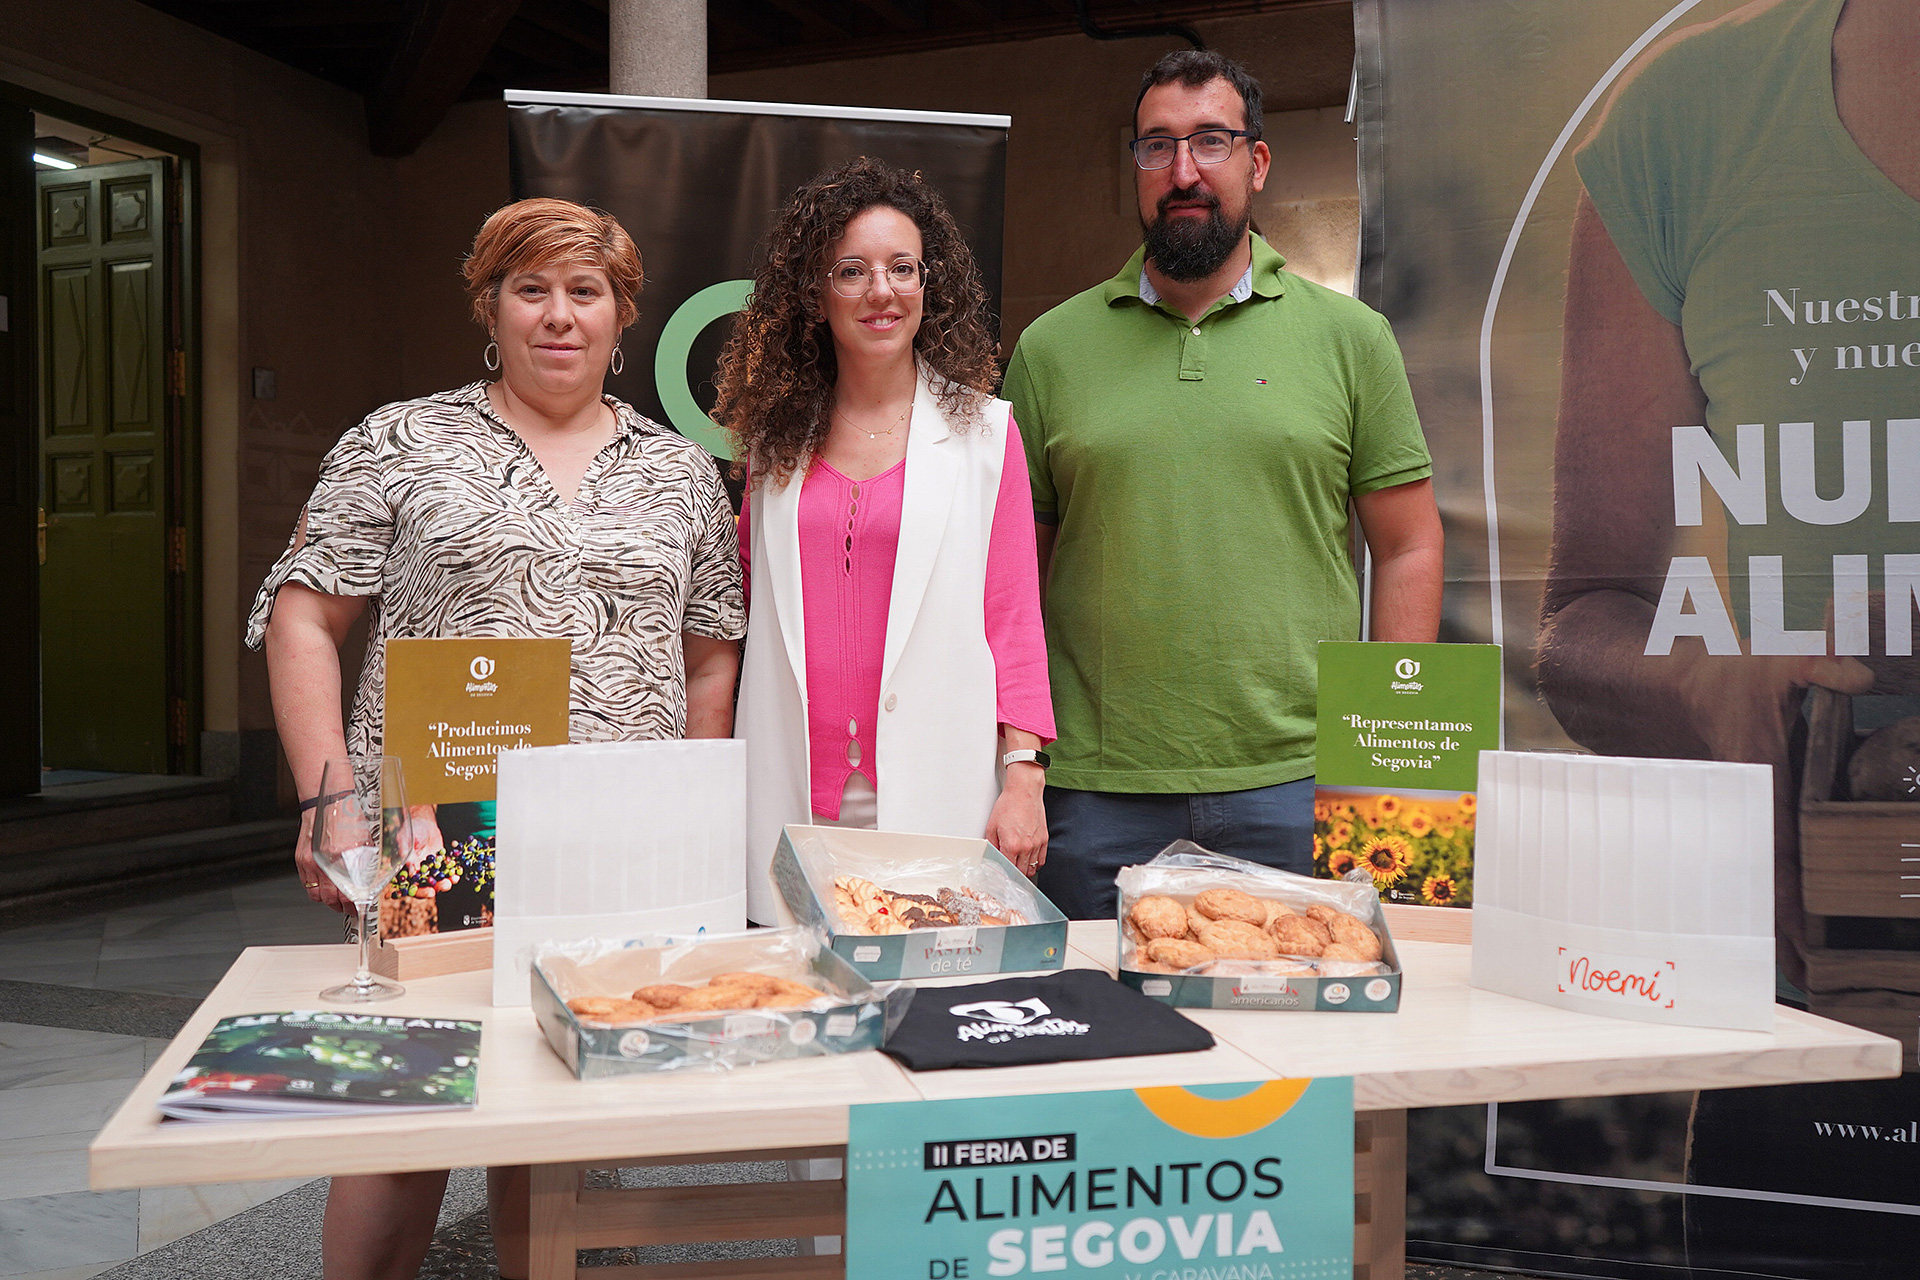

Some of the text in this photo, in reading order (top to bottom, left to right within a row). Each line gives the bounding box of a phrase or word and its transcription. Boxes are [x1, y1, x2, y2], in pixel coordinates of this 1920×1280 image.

[1789, 342, 1920, 386] y nue
[428, 720, 532, 738] “Producimos
[1342, 714, 1473, 733] “Representamos
[426, 741, 509, 758] Alimentos
[1353, 733, 1460, 751] Alimentos de
[444, 759, 498, 781] Segovi
[1371, 752, 1441, 772] Segovia”
[930, 956, 973, 974] de té
[1230, 996, 1300, 1007] americanos
[1813, 1121, 1919, 1143] www.al
[932, 1137, 1068, 1167] II FERIA DE
[924, 1157, 1285, 1224] ALIMENTOS
[929, 1209, 1285, 1280] DE SEGOVIA
